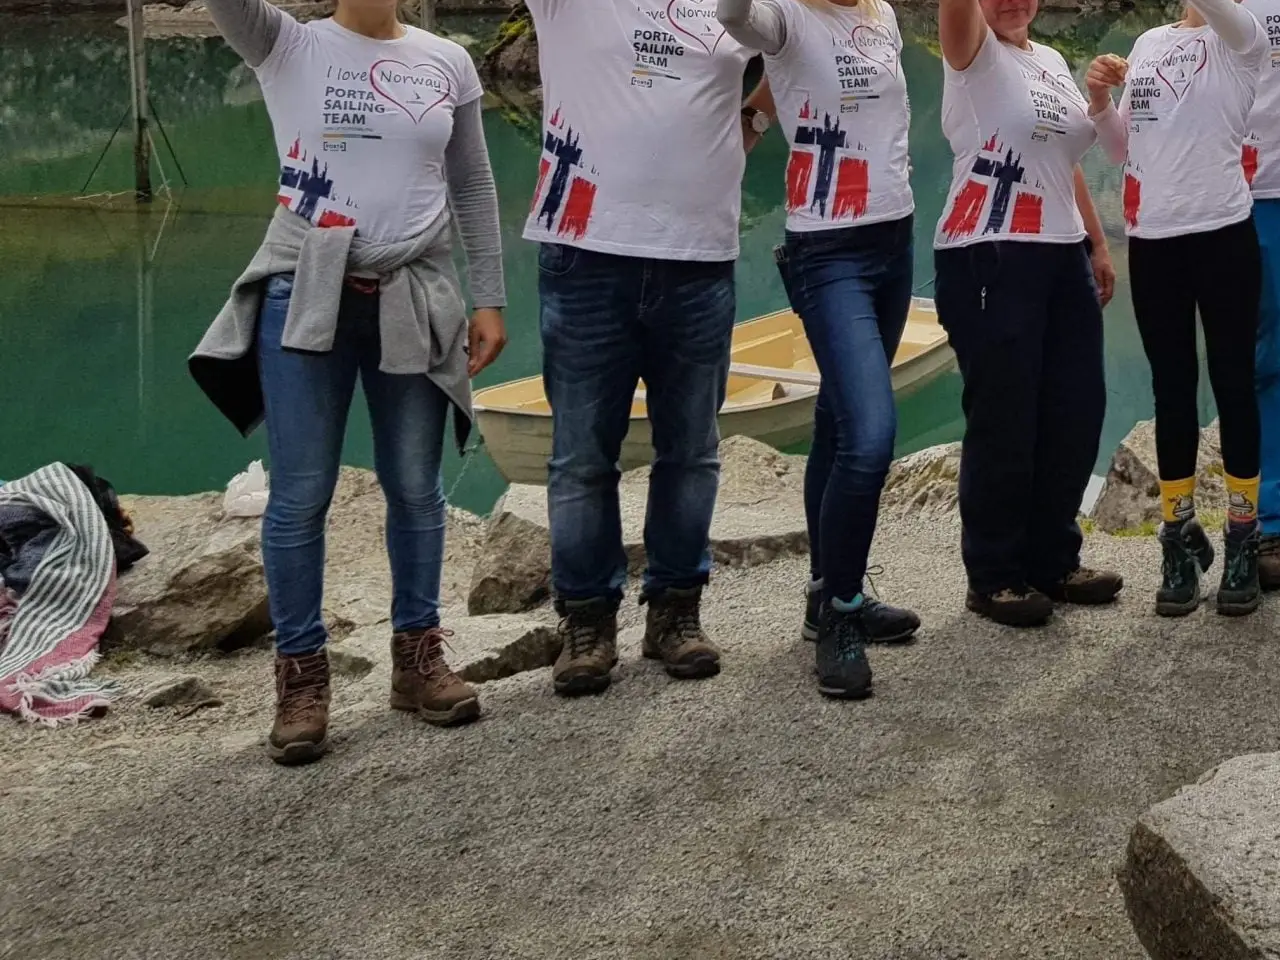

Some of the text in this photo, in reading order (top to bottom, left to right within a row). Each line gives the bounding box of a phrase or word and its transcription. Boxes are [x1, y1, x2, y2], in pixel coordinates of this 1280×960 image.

[634, 29, 677, 43] PORTA
[633, 42, 684, 56] SAILING
[635, 53, 668, 68] TEAM
[837, 66, 878, 77] SAILING
[337, 68, 368, 82] love
[380, 71, 442, 92] Norway
[839, 78, 869, 89] TEAM
[325, 86, 376, 101] PORTA
[1030, 90, 1060, 103] PORTA
[1131, 88, 1160, 98] AILING
[323, 100, 385, 114] SAILING
[1033, 99, 1067, 115] SAILING
[323, 113, 366, 125] TEAM
[1035, 109, 1060, 122] TEAM
